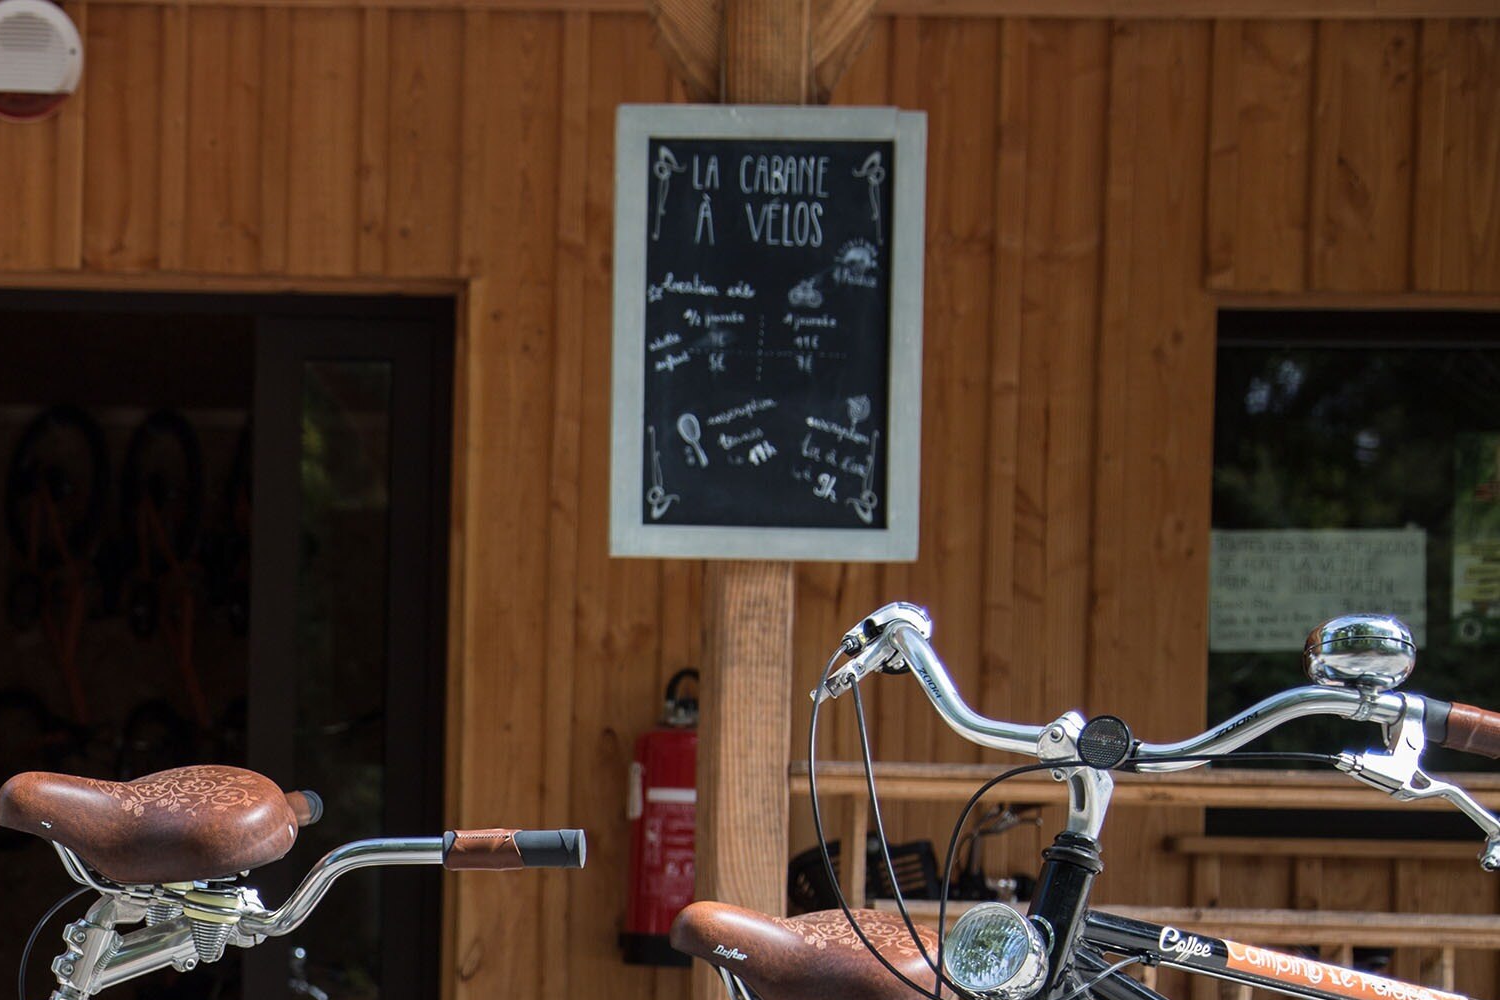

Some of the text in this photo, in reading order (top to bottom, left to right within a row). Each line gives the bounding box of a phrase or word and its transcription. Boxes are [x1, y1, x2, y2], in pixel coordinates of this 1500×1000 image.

[692, 153, 831, 198] LA CABANE
[694, 192, 716, 246] À
[712, 944, 748, 960] Drifter
[1159, 926, 1212, 961] Coffee
